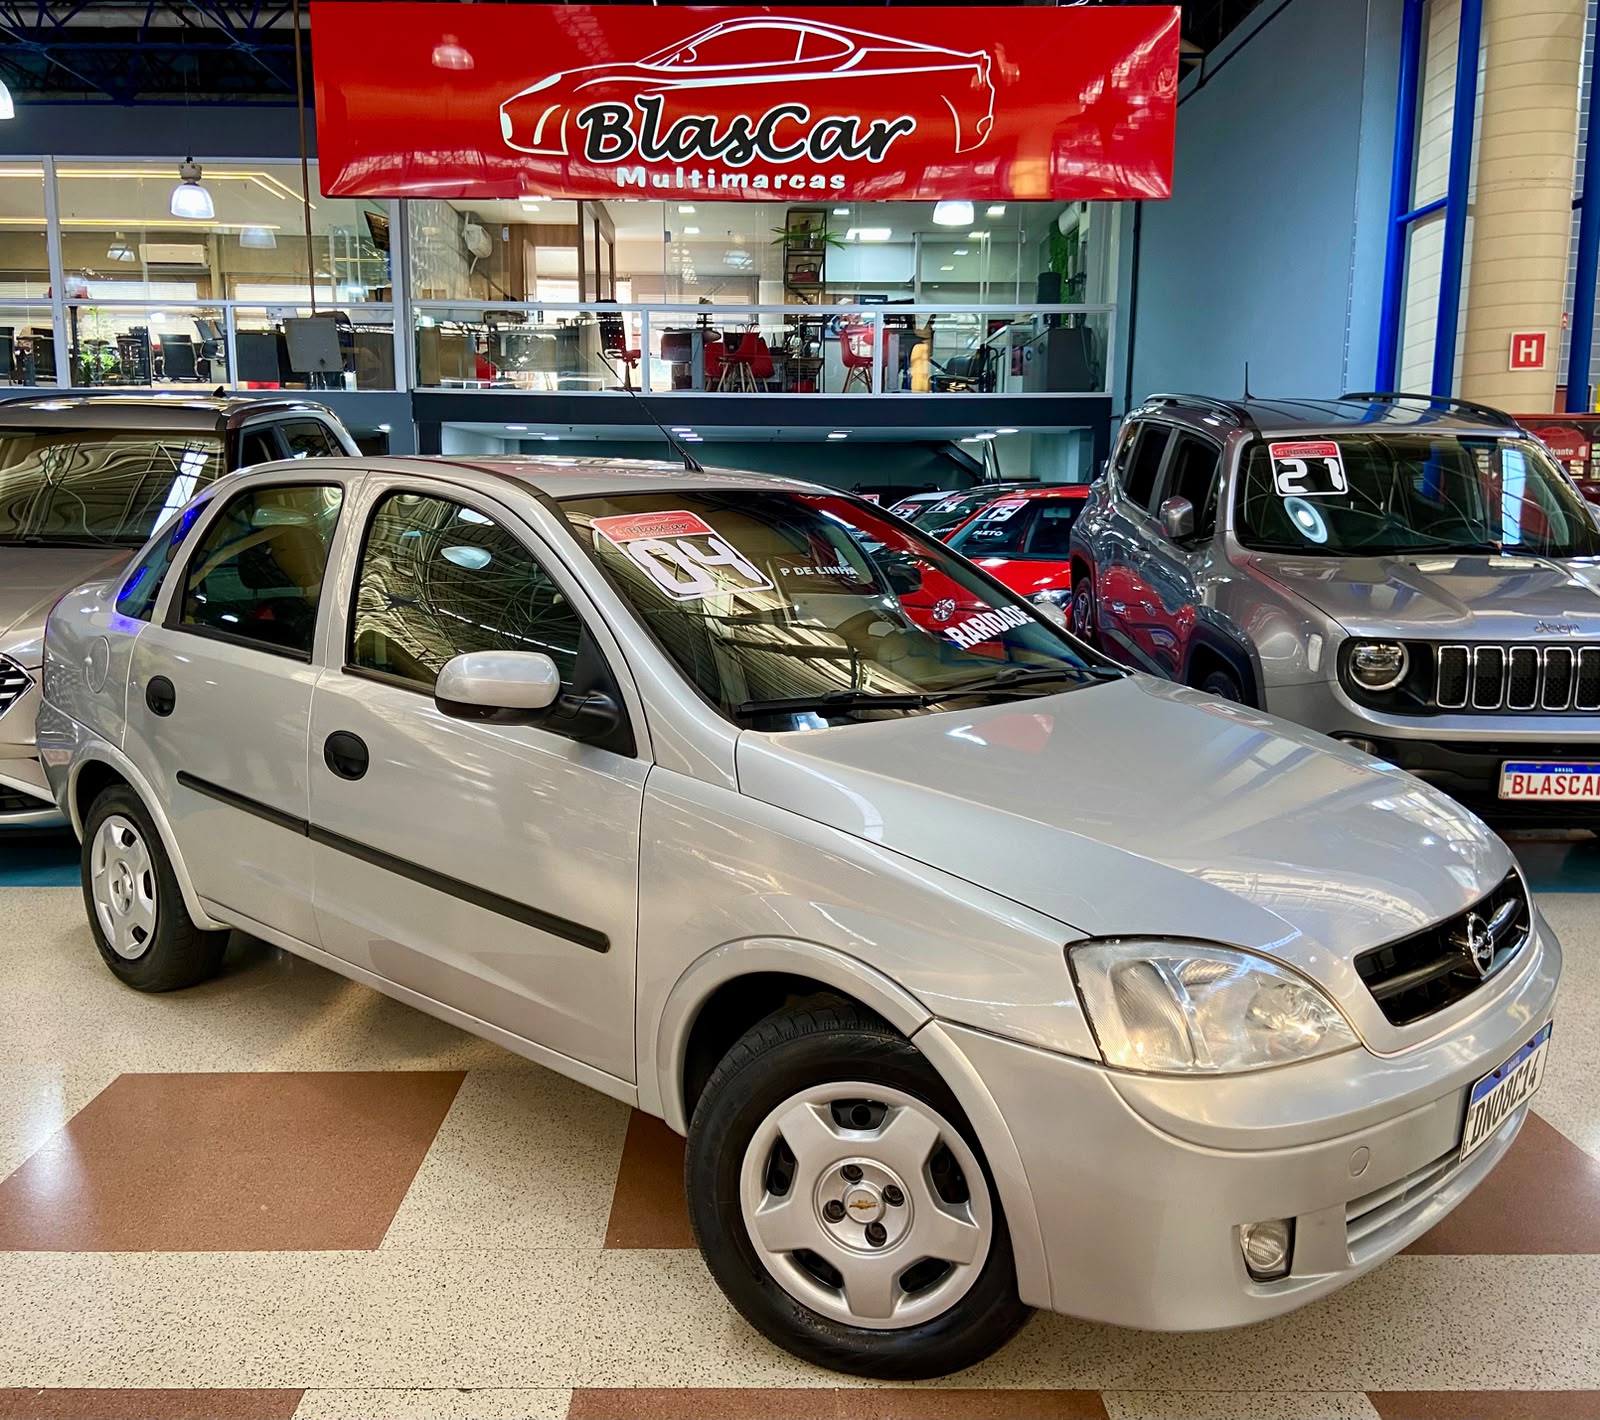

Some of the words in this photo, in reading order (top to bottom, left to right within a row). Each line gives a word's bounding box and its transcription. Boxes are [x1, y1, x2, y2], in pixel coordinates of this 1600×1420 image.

[577, 94, 917, 167] BlasCar
[616, 166, 846, 189] Multimarcas
[1519, 340, 1537, 362] H
[1278, 458, 1343, 493] 21
[987, 506, 1017, 521] 15
[627, 537, 762, 594] 04
[780, 567, 790, 576] P
[793, 566, 814, 576] DE
[815, 566, 859, 576] LINHA
[944, 605, 1036, 649] RARIDADE
